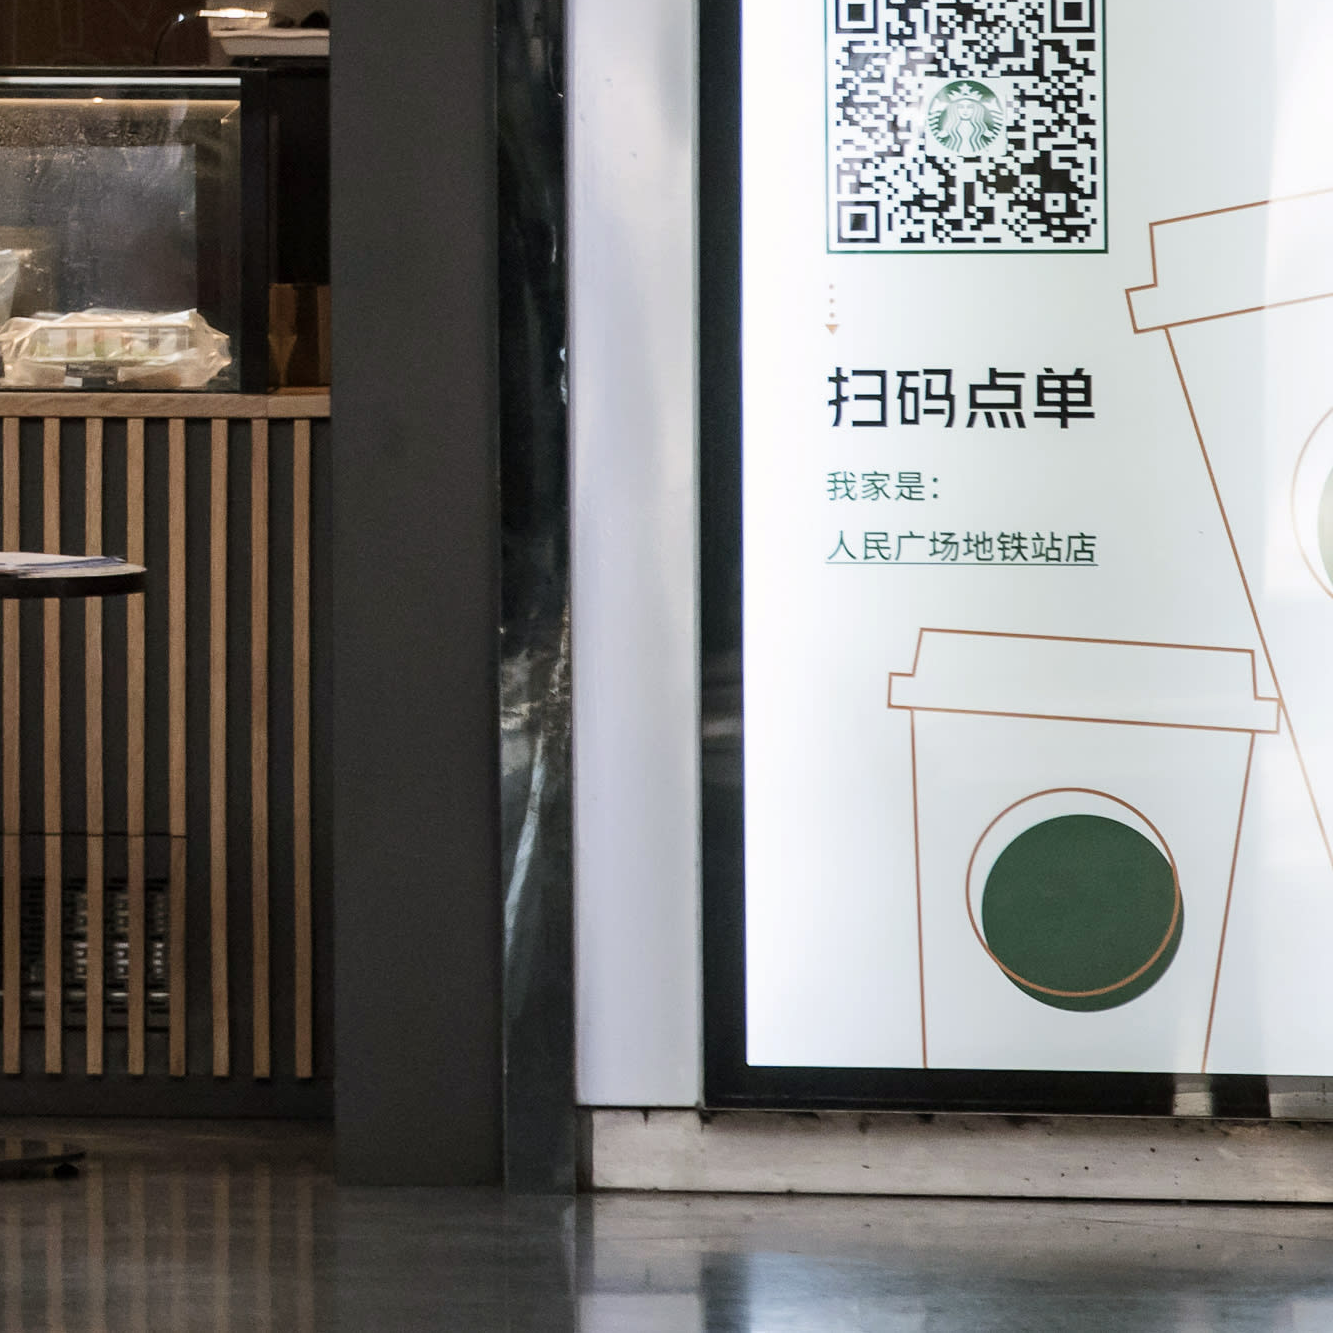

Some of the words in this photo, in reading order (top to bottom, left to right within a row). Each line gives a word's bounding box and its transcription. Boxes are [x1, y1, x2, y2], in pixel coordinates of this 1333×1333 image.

[827, 366, 1096, 429] 扫码点单
[826, 470, 940, 501] 我家是：
[827, 529, 1098, 563] 人民广场地铁站店
